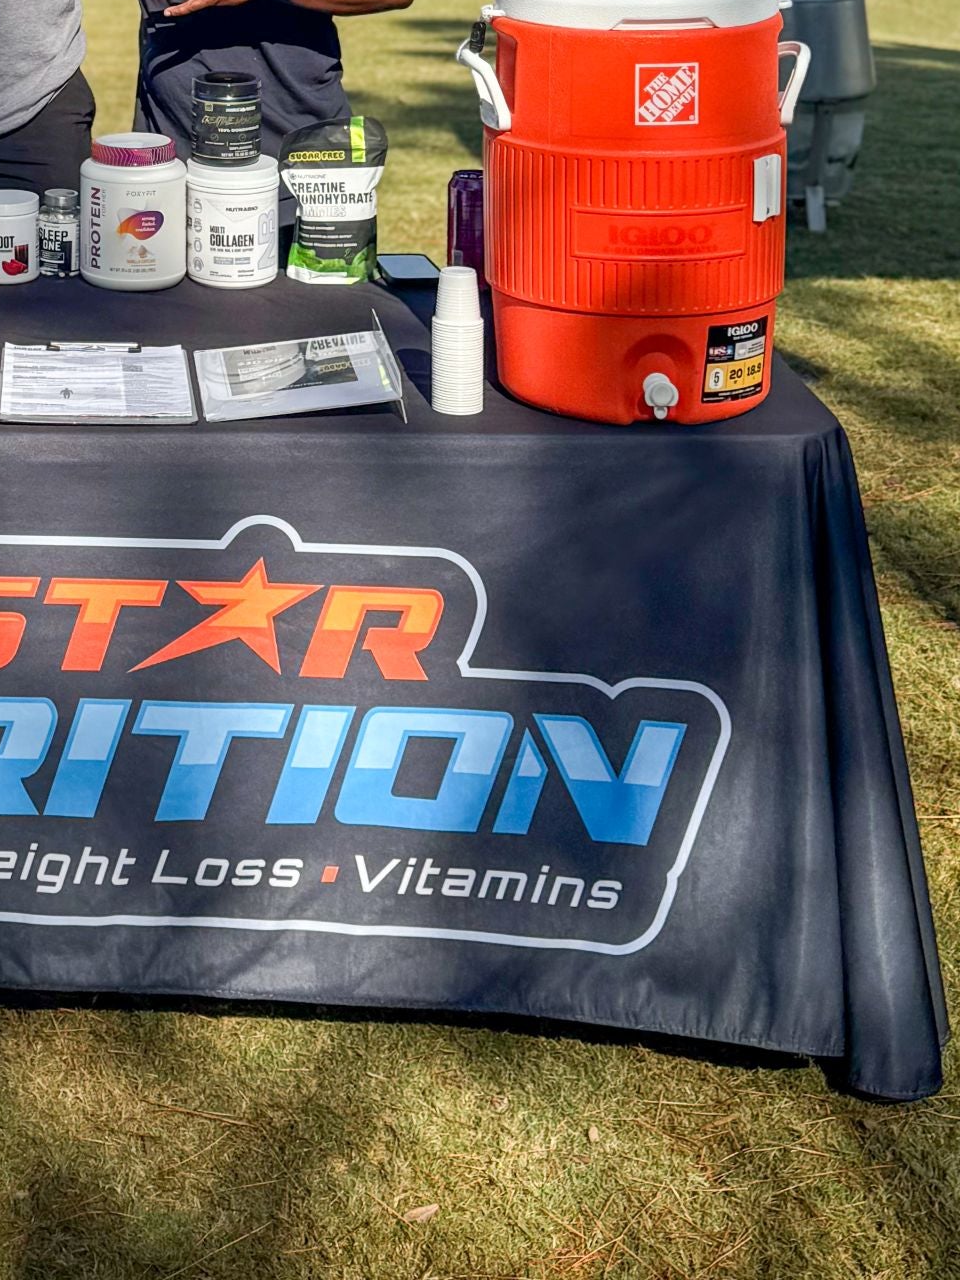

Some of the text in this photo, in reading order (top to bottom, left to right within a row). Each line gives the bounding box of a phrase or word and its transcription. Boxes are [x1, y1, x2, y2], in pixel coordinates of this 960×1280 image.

[643, 72, 670, 96] THE
[639, 66, 696, 123] HOME
[660, 85, 696, 122] DEPOT
[289, 151, 344, 161] SUGAR FREE
[291, 182, 346, 194] CREATINE
[38, 227, 69, 242] SLEEP
[90, 186, 102, 270] PROTEIN
[209, 225, 226, 234] MULTI
[209, 234, 255, 247] COLLAGEN
[608, 224, 713, 247] IGLOO
[42, 240, 62, 252] ONE
[727, 322, 759, 337] IGLOO
[729, 368, 743, 380] 20
[746, 362, 762, 376] 18.9
[713, 371, 720, 384] 5
[151, 848, 304, 891] Loss
[353, 854, 623, 910] Vitamins
